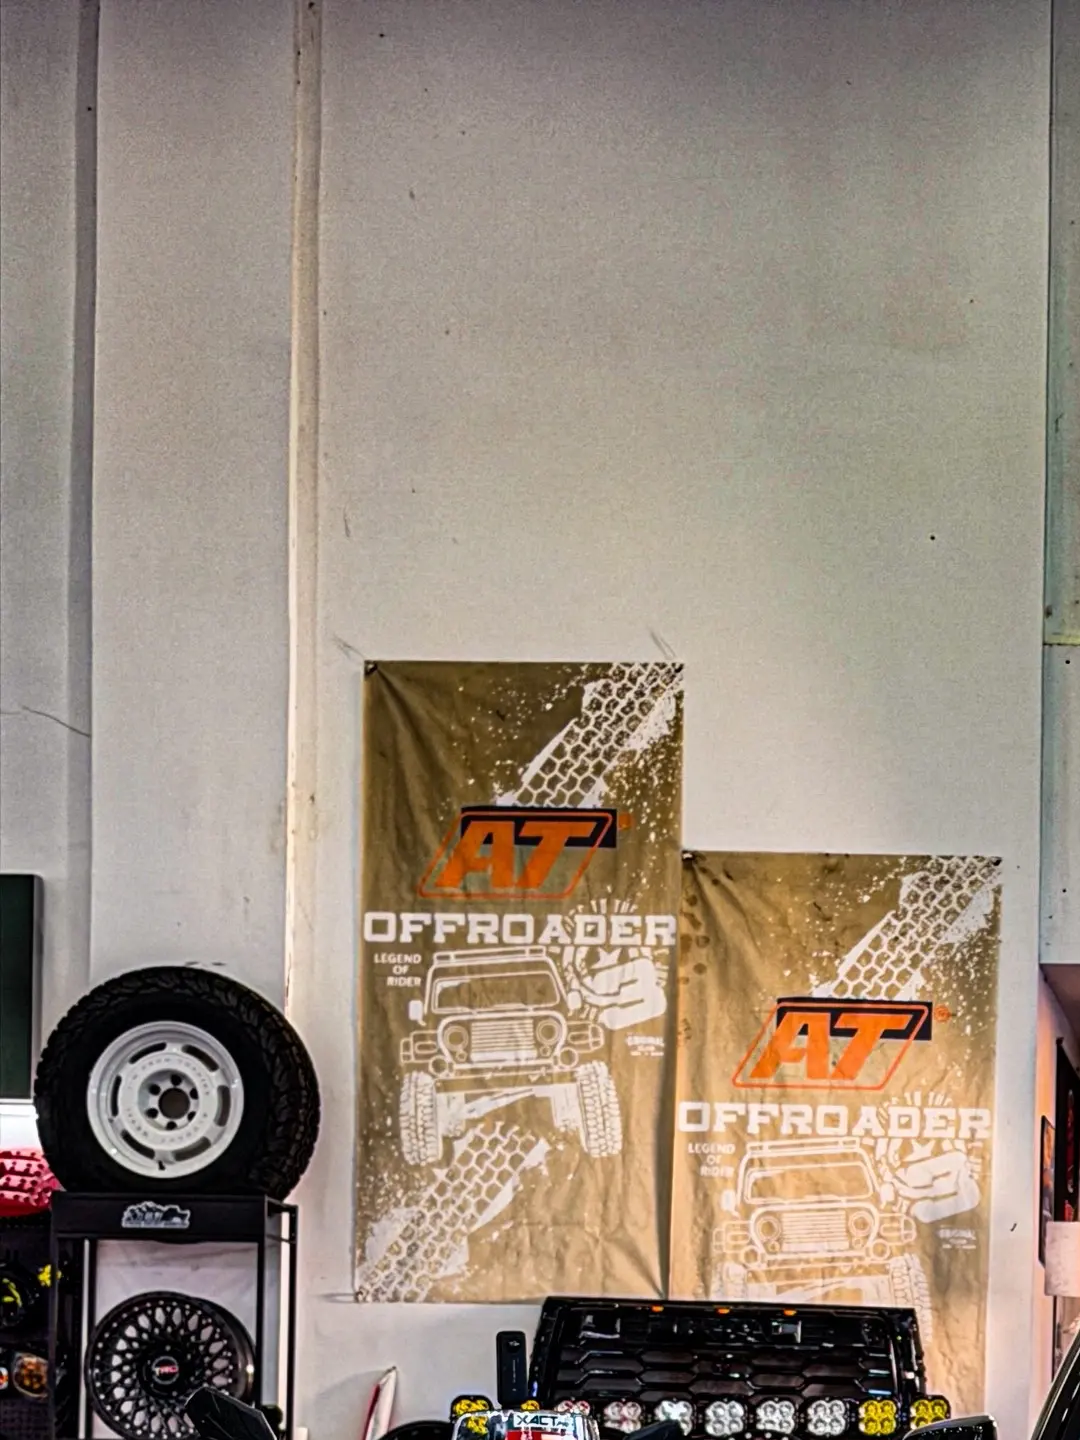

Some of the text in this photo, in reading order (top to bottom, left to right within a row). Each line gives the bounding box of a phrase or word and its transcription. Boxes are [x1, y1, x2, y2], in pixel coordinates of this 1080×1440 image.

[434, 820, 597, 890] AT
[364, 911, 677, 946] OFFROADER
[374, 953, 422, 965] LEGEND
[392, 965, 409, 975] OF
[387, 976, 422, 988] RIDER
[747, 1011, 910, 1082] AT
[678, 1101, 992, 1138] OFFROADER
[688, 1143, 735, 1155] LEGEND
[706, 1154, 722, 1165] OF
